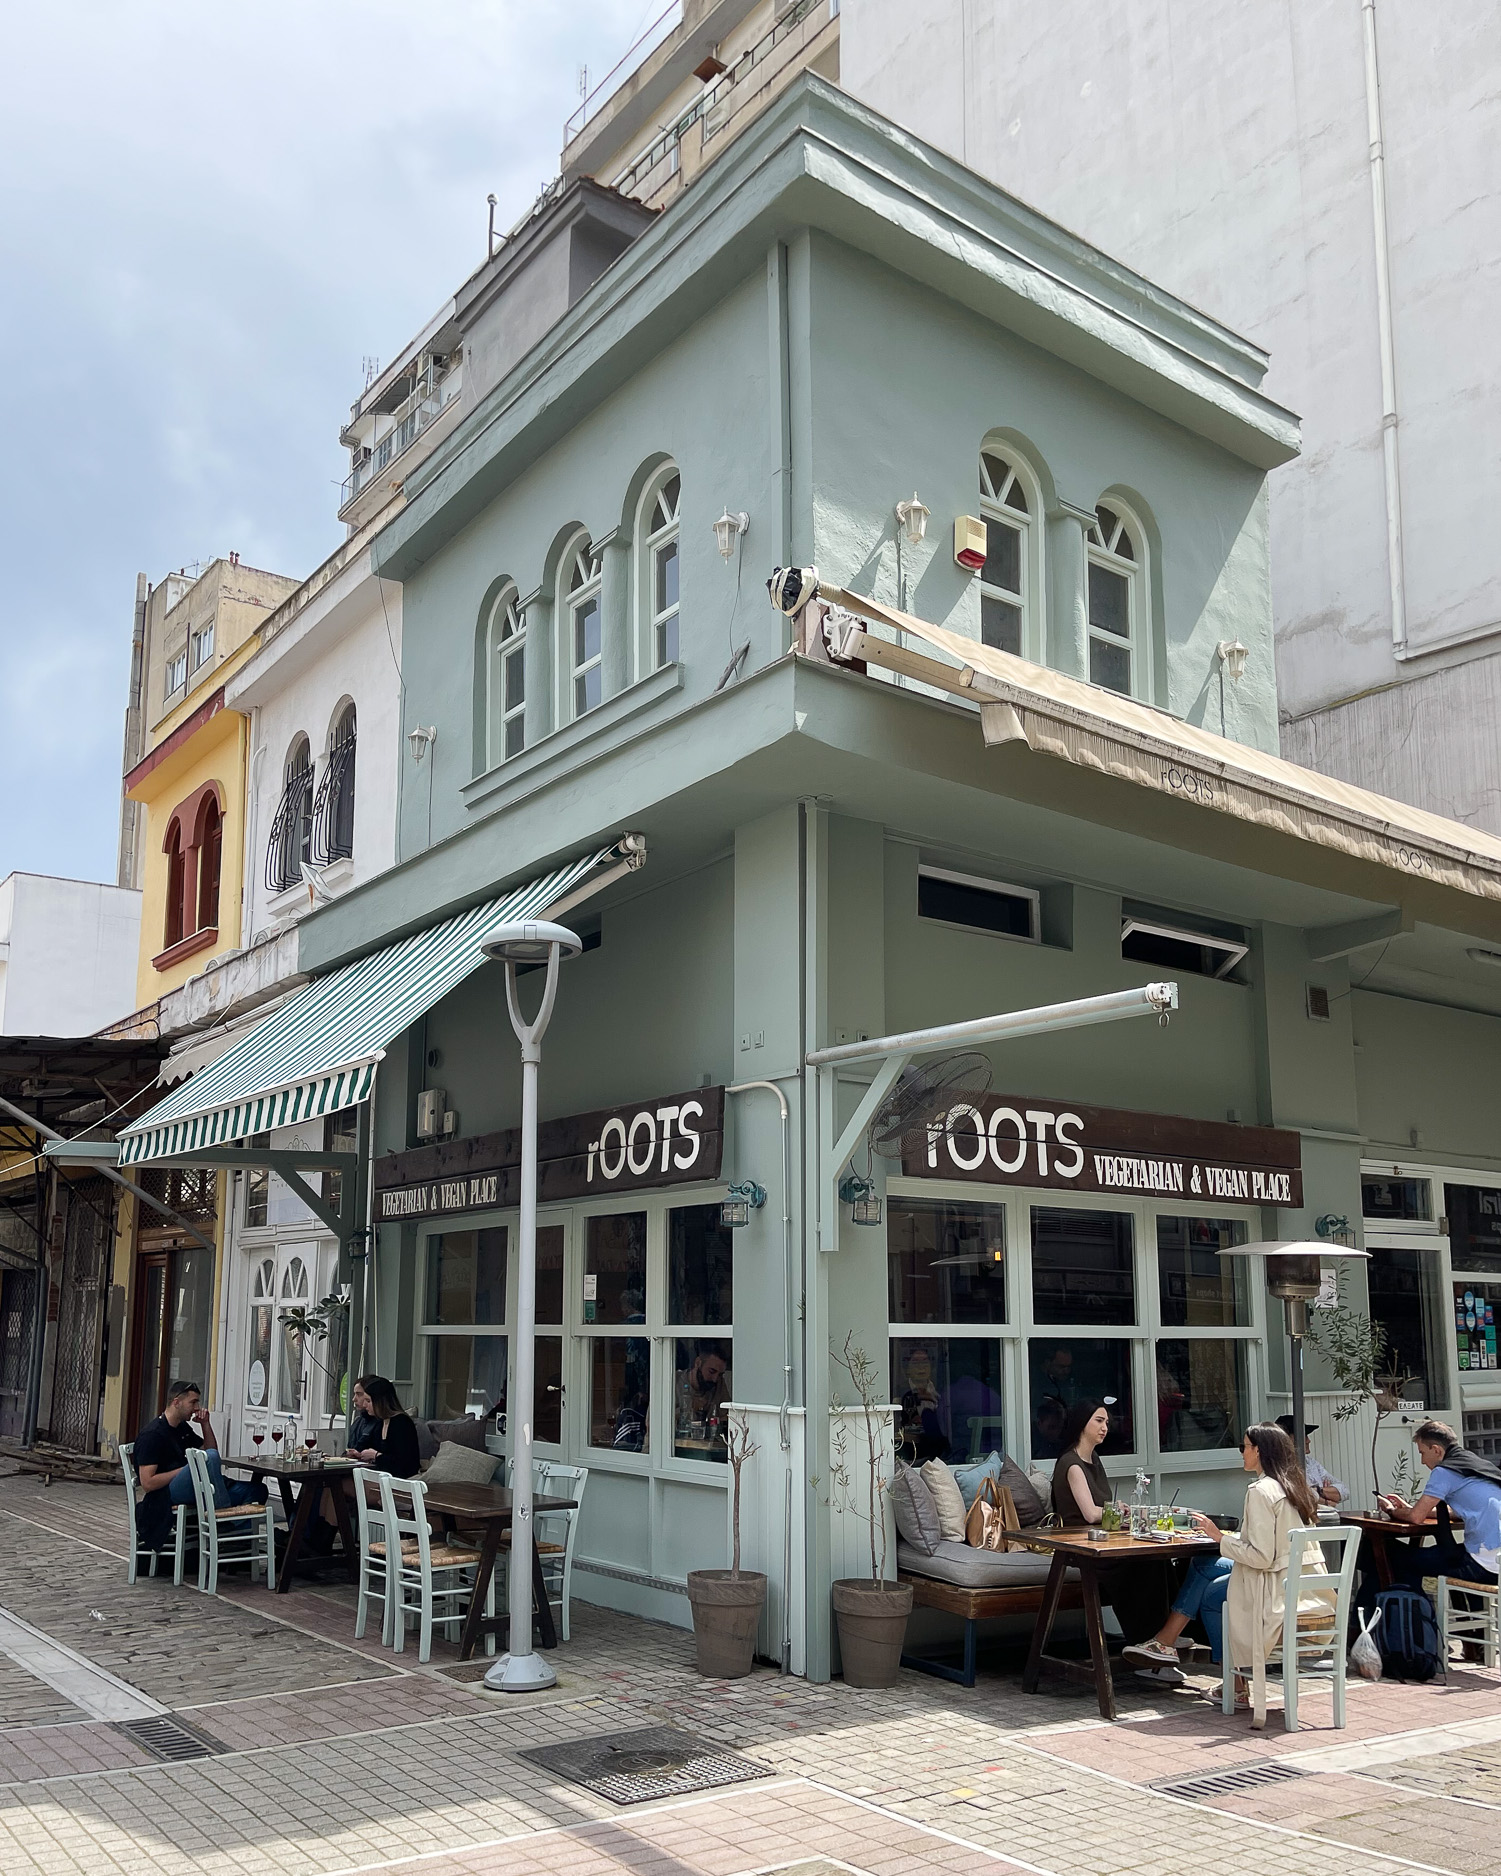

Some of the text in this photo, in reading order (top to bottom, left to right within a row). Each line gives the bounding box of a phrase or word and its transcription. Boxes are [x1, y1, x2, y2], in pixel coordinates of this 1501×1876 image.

[586, 1100, 703, 1182] rOOTS
[926, 1103, 1085, 1179] rOOTS
[382, 1176, 498, 1217] VEGETARIAN & VEGAN PLACE
[1093, 1154, 1291, 1202] VEGETARIAN & VEGAN PLACE
